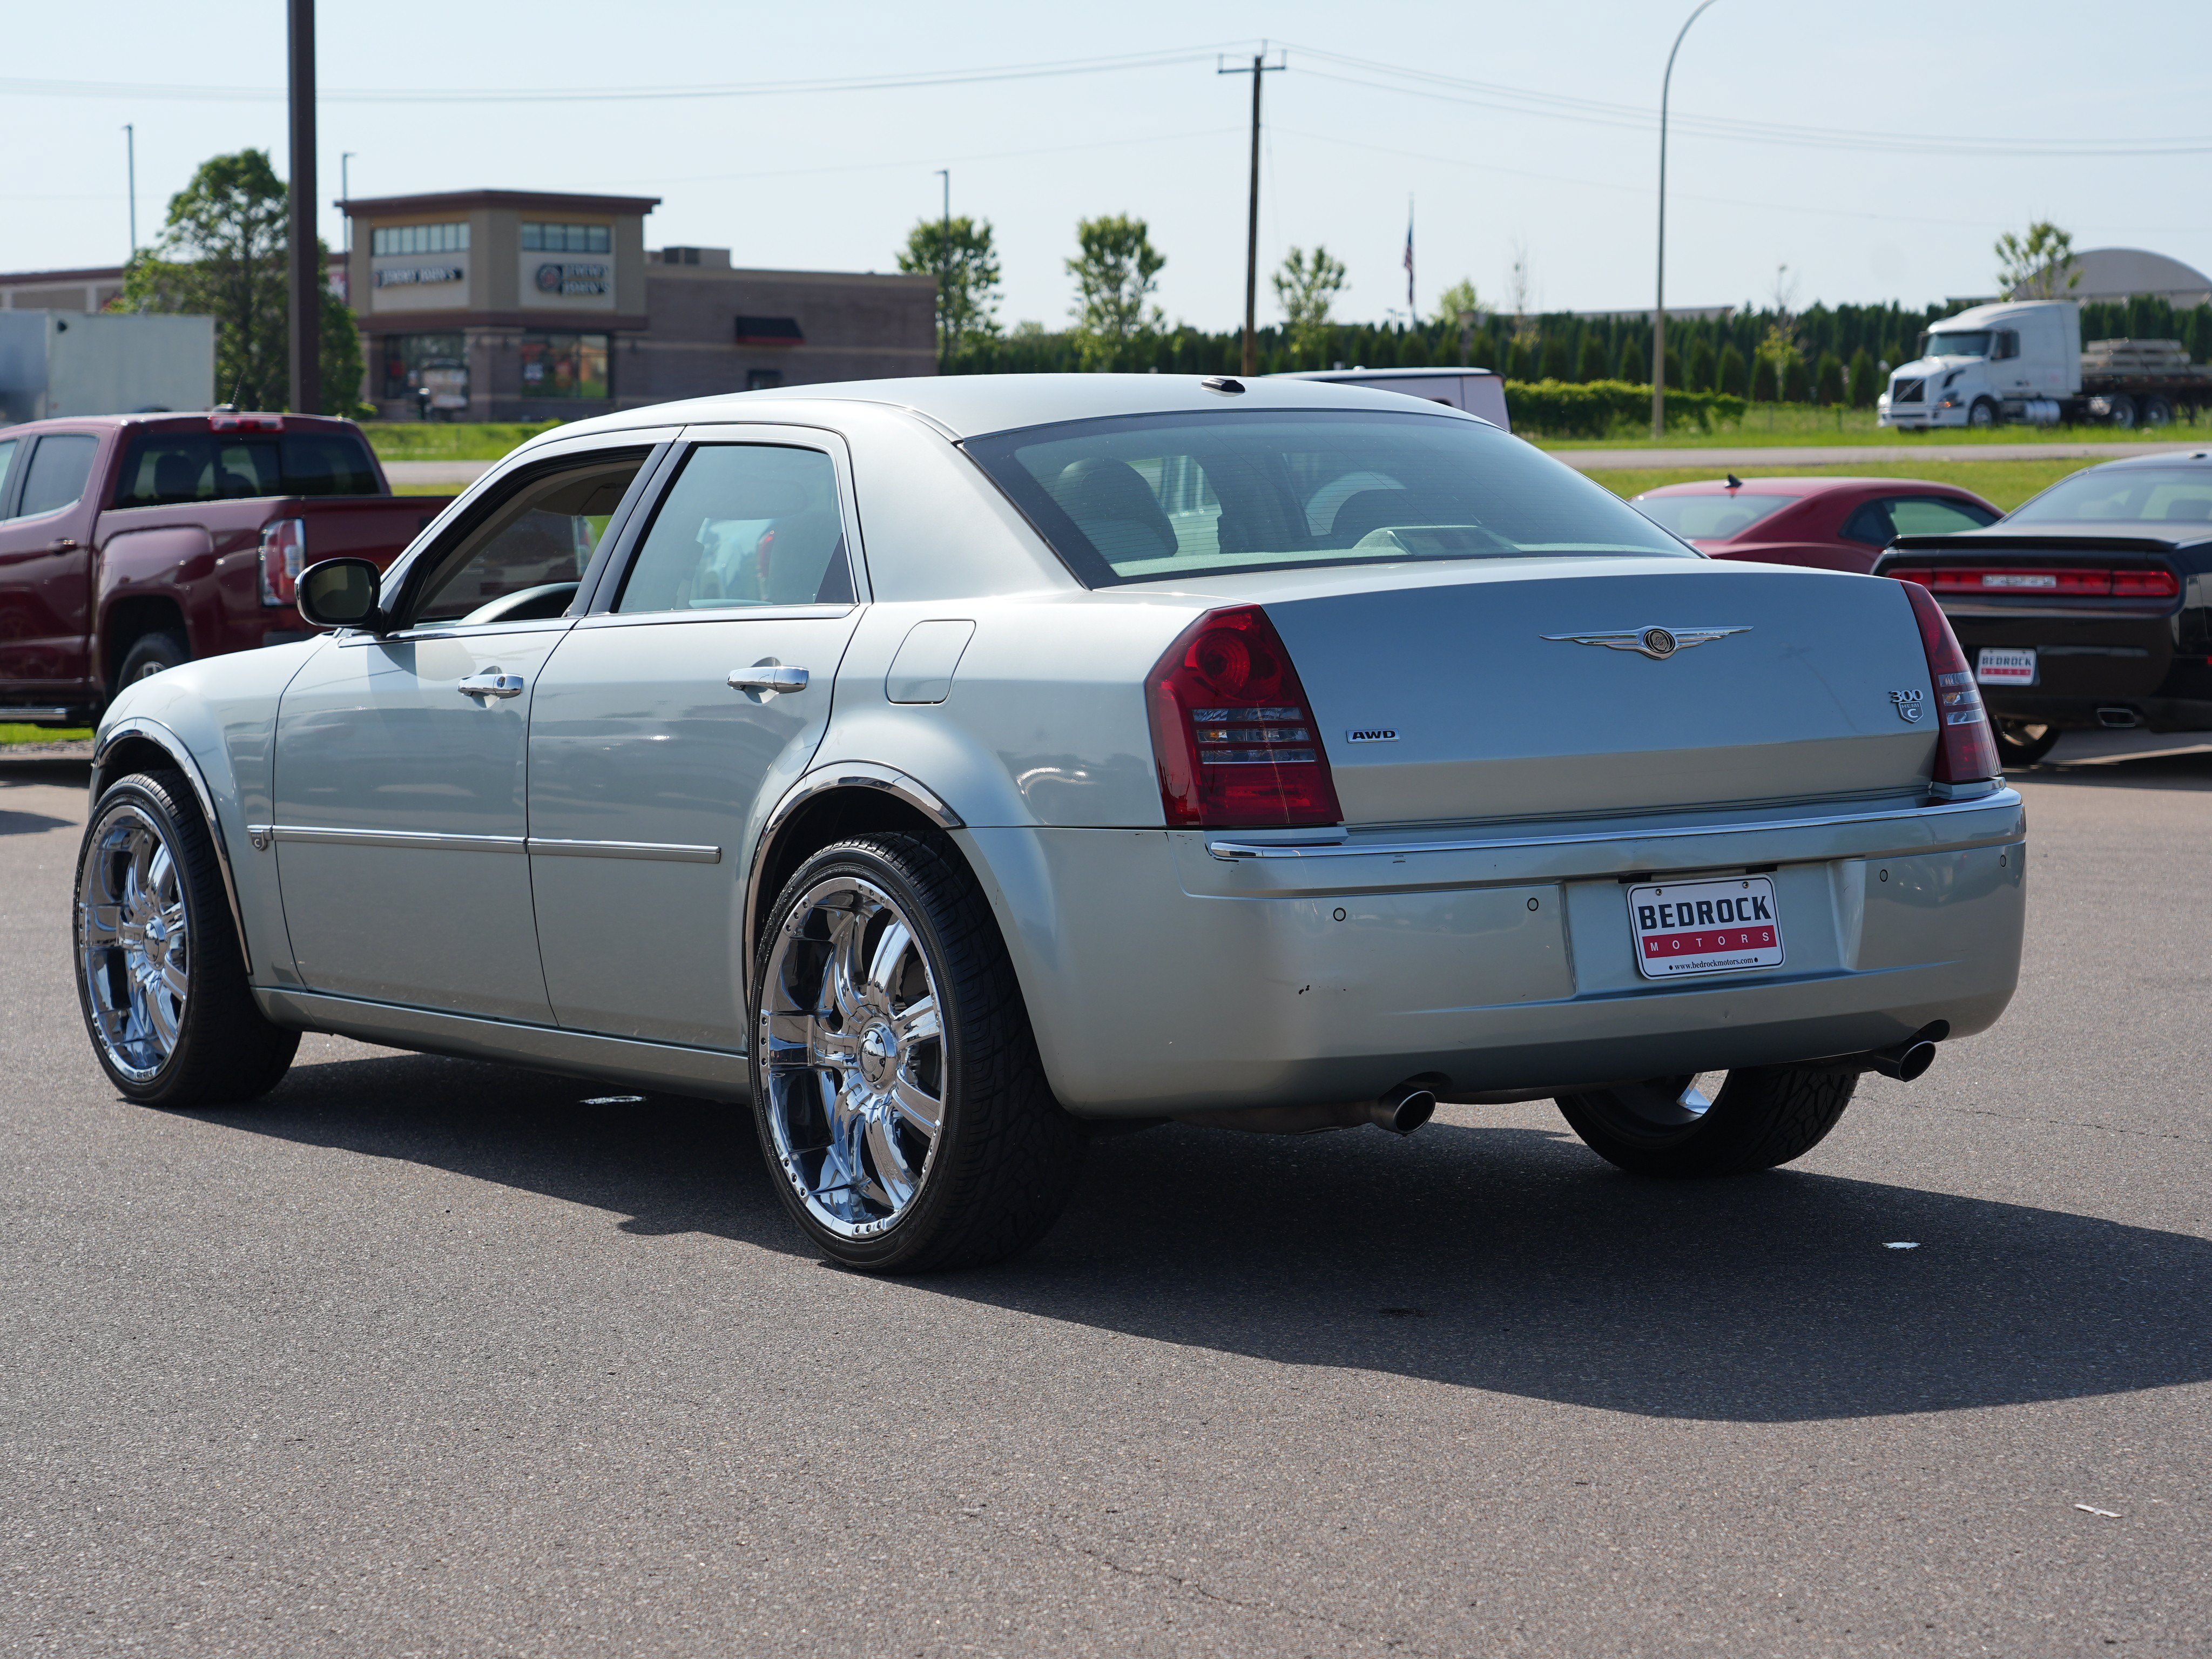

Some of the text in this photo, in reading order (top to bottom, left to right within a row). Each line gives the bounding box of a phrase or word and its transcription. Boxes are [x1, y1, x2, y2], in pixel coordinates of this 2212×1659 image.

[1982, 655, 2032, 666] BEDROCK
[1889, 689, 1924, 703] 300
[1907, 709, 1918, 718] C
[1352, 730, 1395, 740] AWD
[1638, 895, 1771, 930] BEDROCK
[1650, 932, 1769, 952] MOTORS
[1675, 956, 1754, 970] www.bedrockmotors.com
